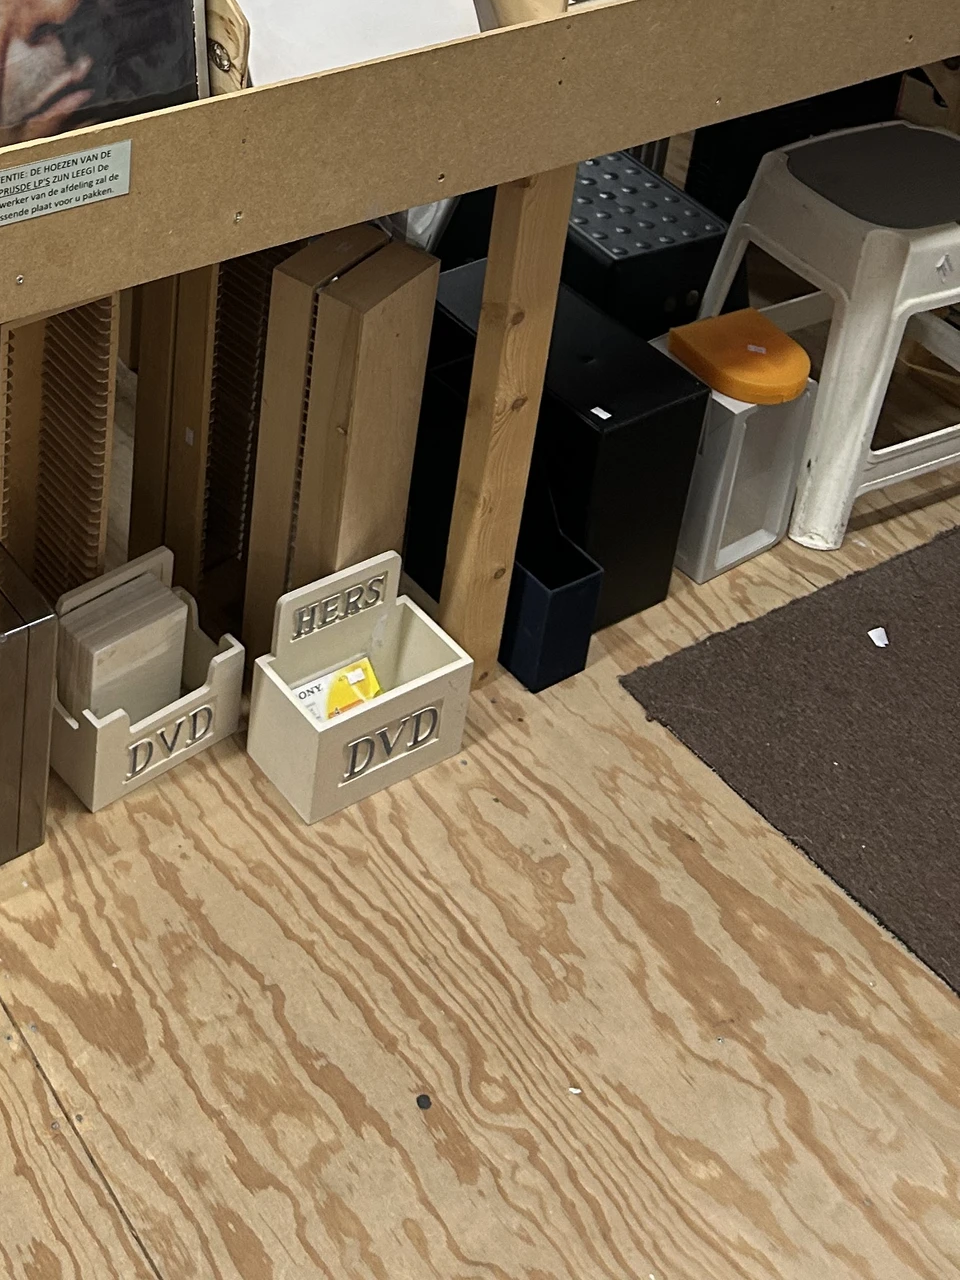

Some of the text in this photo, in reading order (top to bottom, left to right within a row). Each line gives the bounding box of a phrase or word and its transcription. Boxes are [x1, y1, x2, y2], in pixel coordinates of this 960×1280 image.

[31, 168, 41, 177] DE
[44, 160, 78, 173] HOEZEN
[80, 154, 98, 164] VAN
[101, 150, 112, 159] DE
[33, 177, 51, 188] LP'S
[52, 174, 69, 183] ZIJN
[72, 166, 96, 178] LEEG!
[98, 164, 109, 173] De
[31, 193, 46, 201] van
[48, 187, 59, 196] de
[61, 180, 93, 194] afdeling
[96, 177, 107, 186] zal
[109, 173, 119, 181] de
[32, 202, 52, 214] plaat
[54, 197, 73, 207] voor
[83, 187, 114, 202] pakken.
[292, 574, 387, 641] HERS
[299, 684, 323, 700] ONY
[125, 704, 214, 783] DVD
[342, 705, 440, 783] DVD
